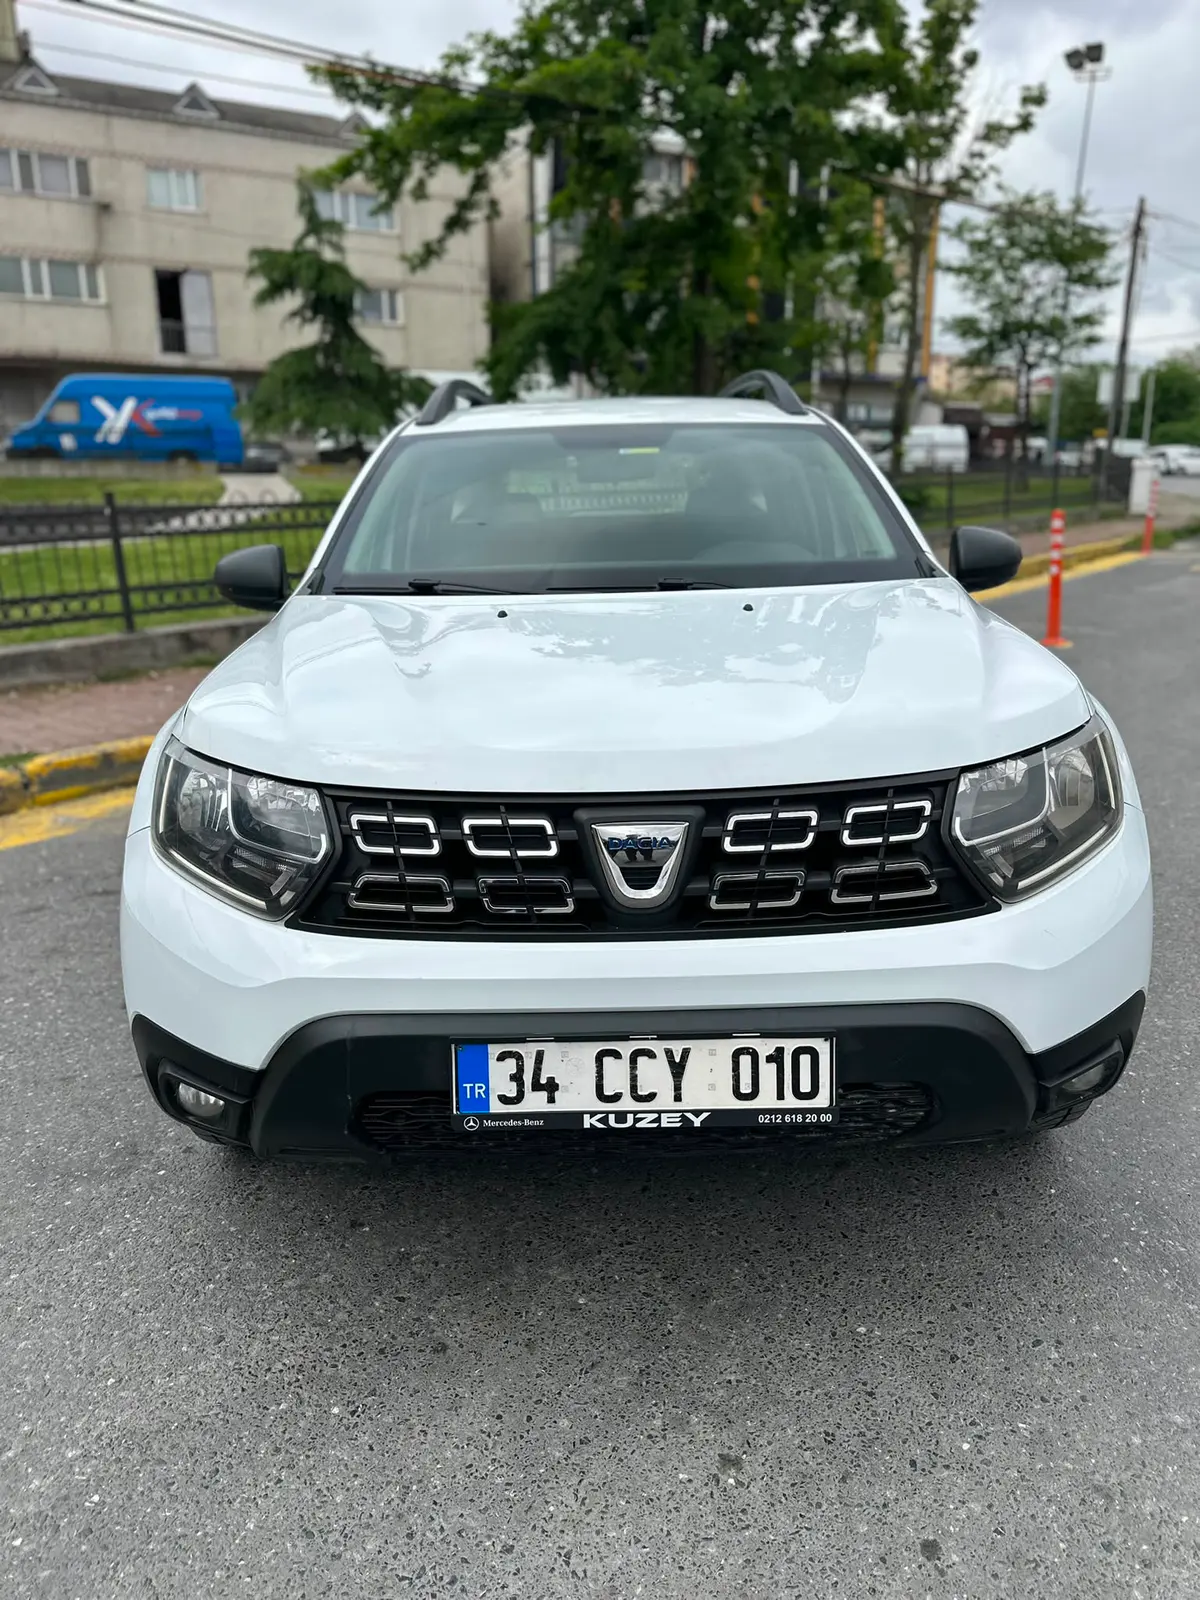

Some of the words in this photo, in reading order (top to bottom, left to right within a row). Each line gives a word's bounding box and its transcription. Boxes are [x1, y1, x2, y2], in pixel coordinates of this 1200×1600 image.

[608, 837, 672, 850] DACIA
[495, 1050, 560, 1106] 34
[594, 1047, 692, 1104] CCY
[731, 1046, 820, 1101] 010
[463, 1083, 486, 1099] TR
[482, 1119, 544, 1128] Mercedes-Benz
[583, 1112, 712, 1128] KUZEY
[758, 1114, 782, 1123] 0212
[784, 1114, 803, 1123] 618
[805, 1114, 817, 1123] 20
[820, 1113, 832, 1122] 00
